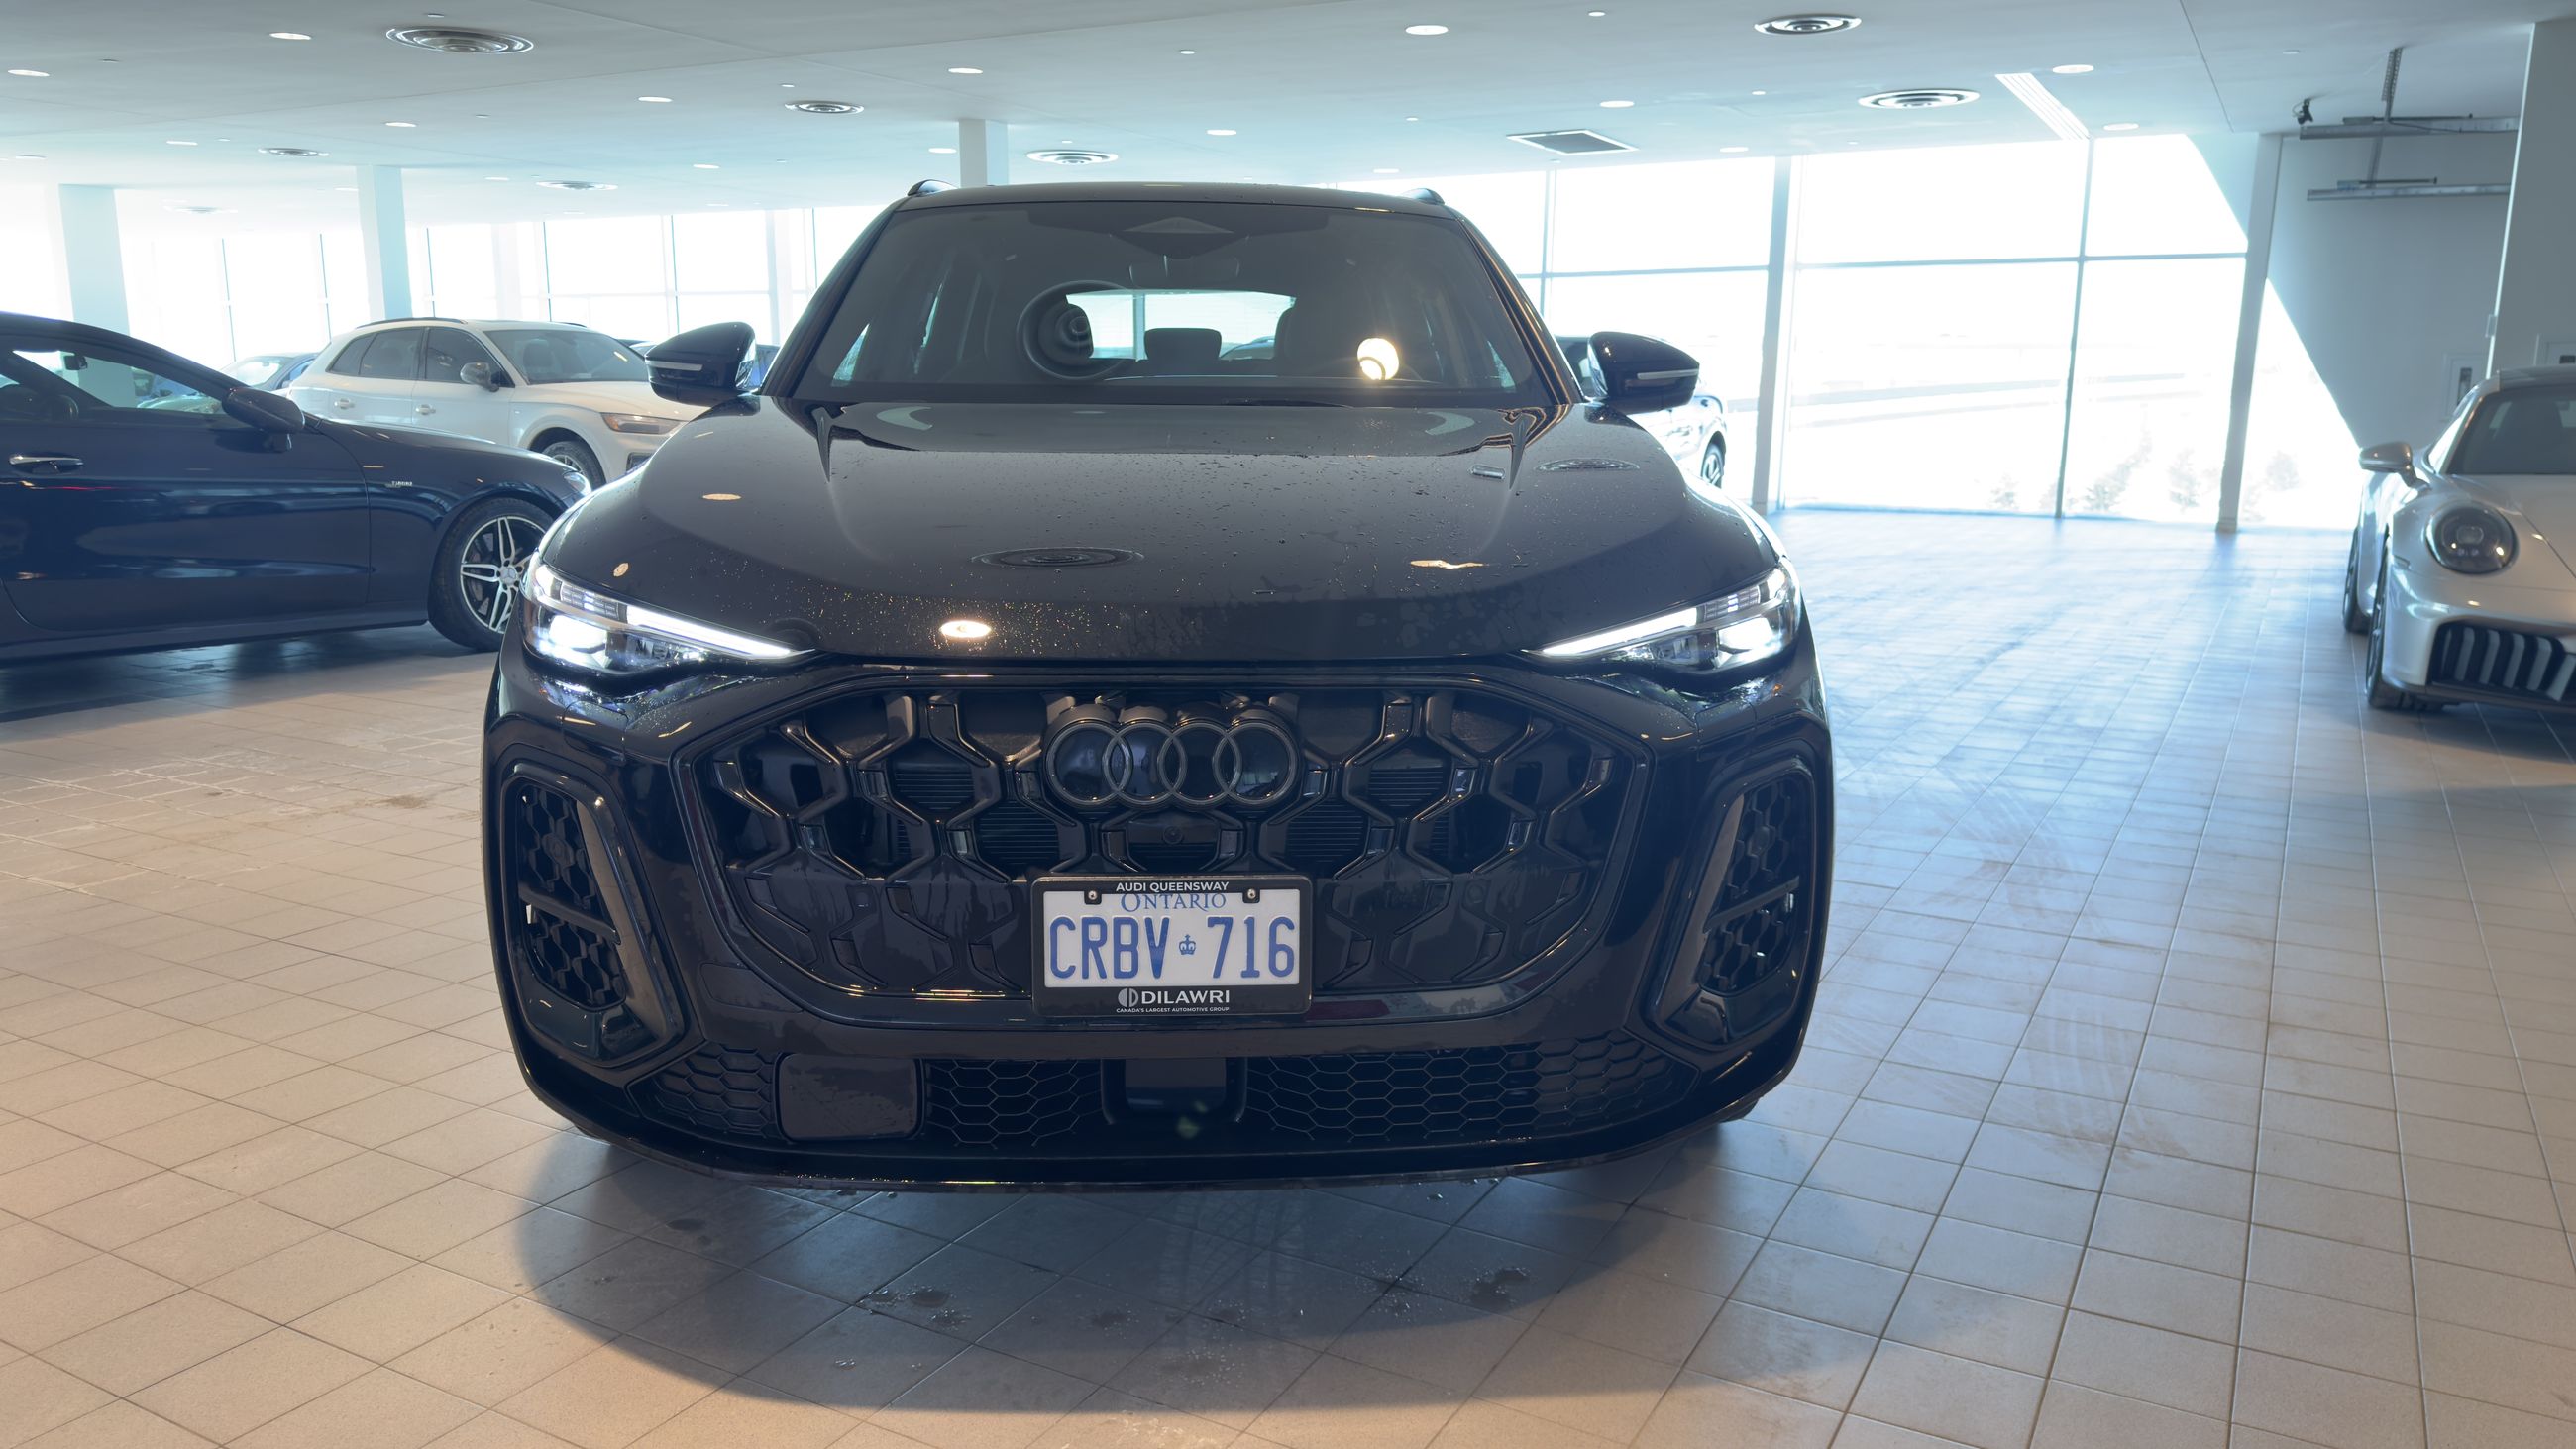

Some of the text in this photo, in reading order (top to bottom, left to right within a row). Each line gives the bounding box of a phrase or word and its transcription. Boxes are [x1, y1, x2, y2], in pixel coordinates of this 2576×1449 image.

[1116, 881, 1230, 892] AUDI QUEENSWAY
[1121, 893, 1227, 912] ONTARIO
[1050, 916, 1295, 980] CRBV 716
[1141, 990, 1230, 1004] DILAWRI
